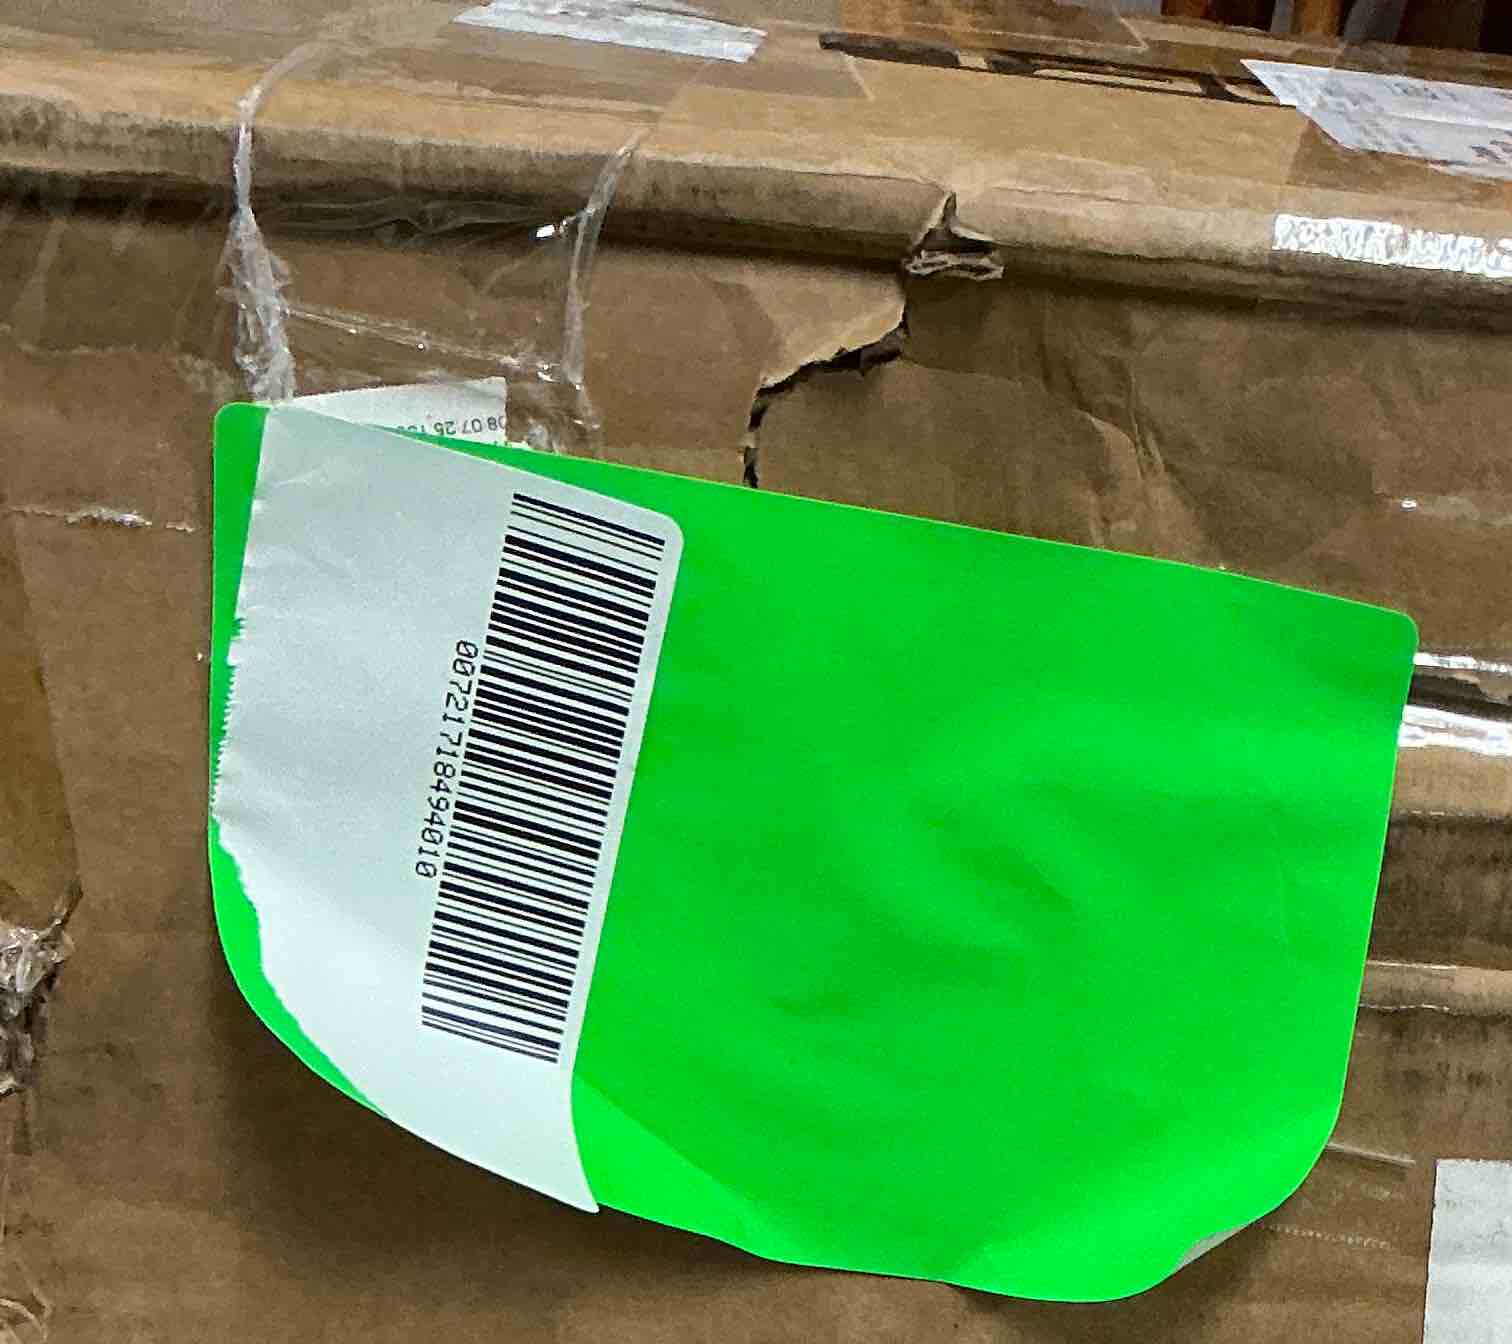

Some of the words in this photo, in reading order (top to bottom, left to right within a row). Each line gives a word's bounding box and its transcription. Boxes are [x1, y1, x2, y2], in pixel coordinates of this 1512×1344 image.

[433, 421, 457, 436] 25
[462, 419, 483, 434] 07
[415, 639, 479, 879] 00721718494010
